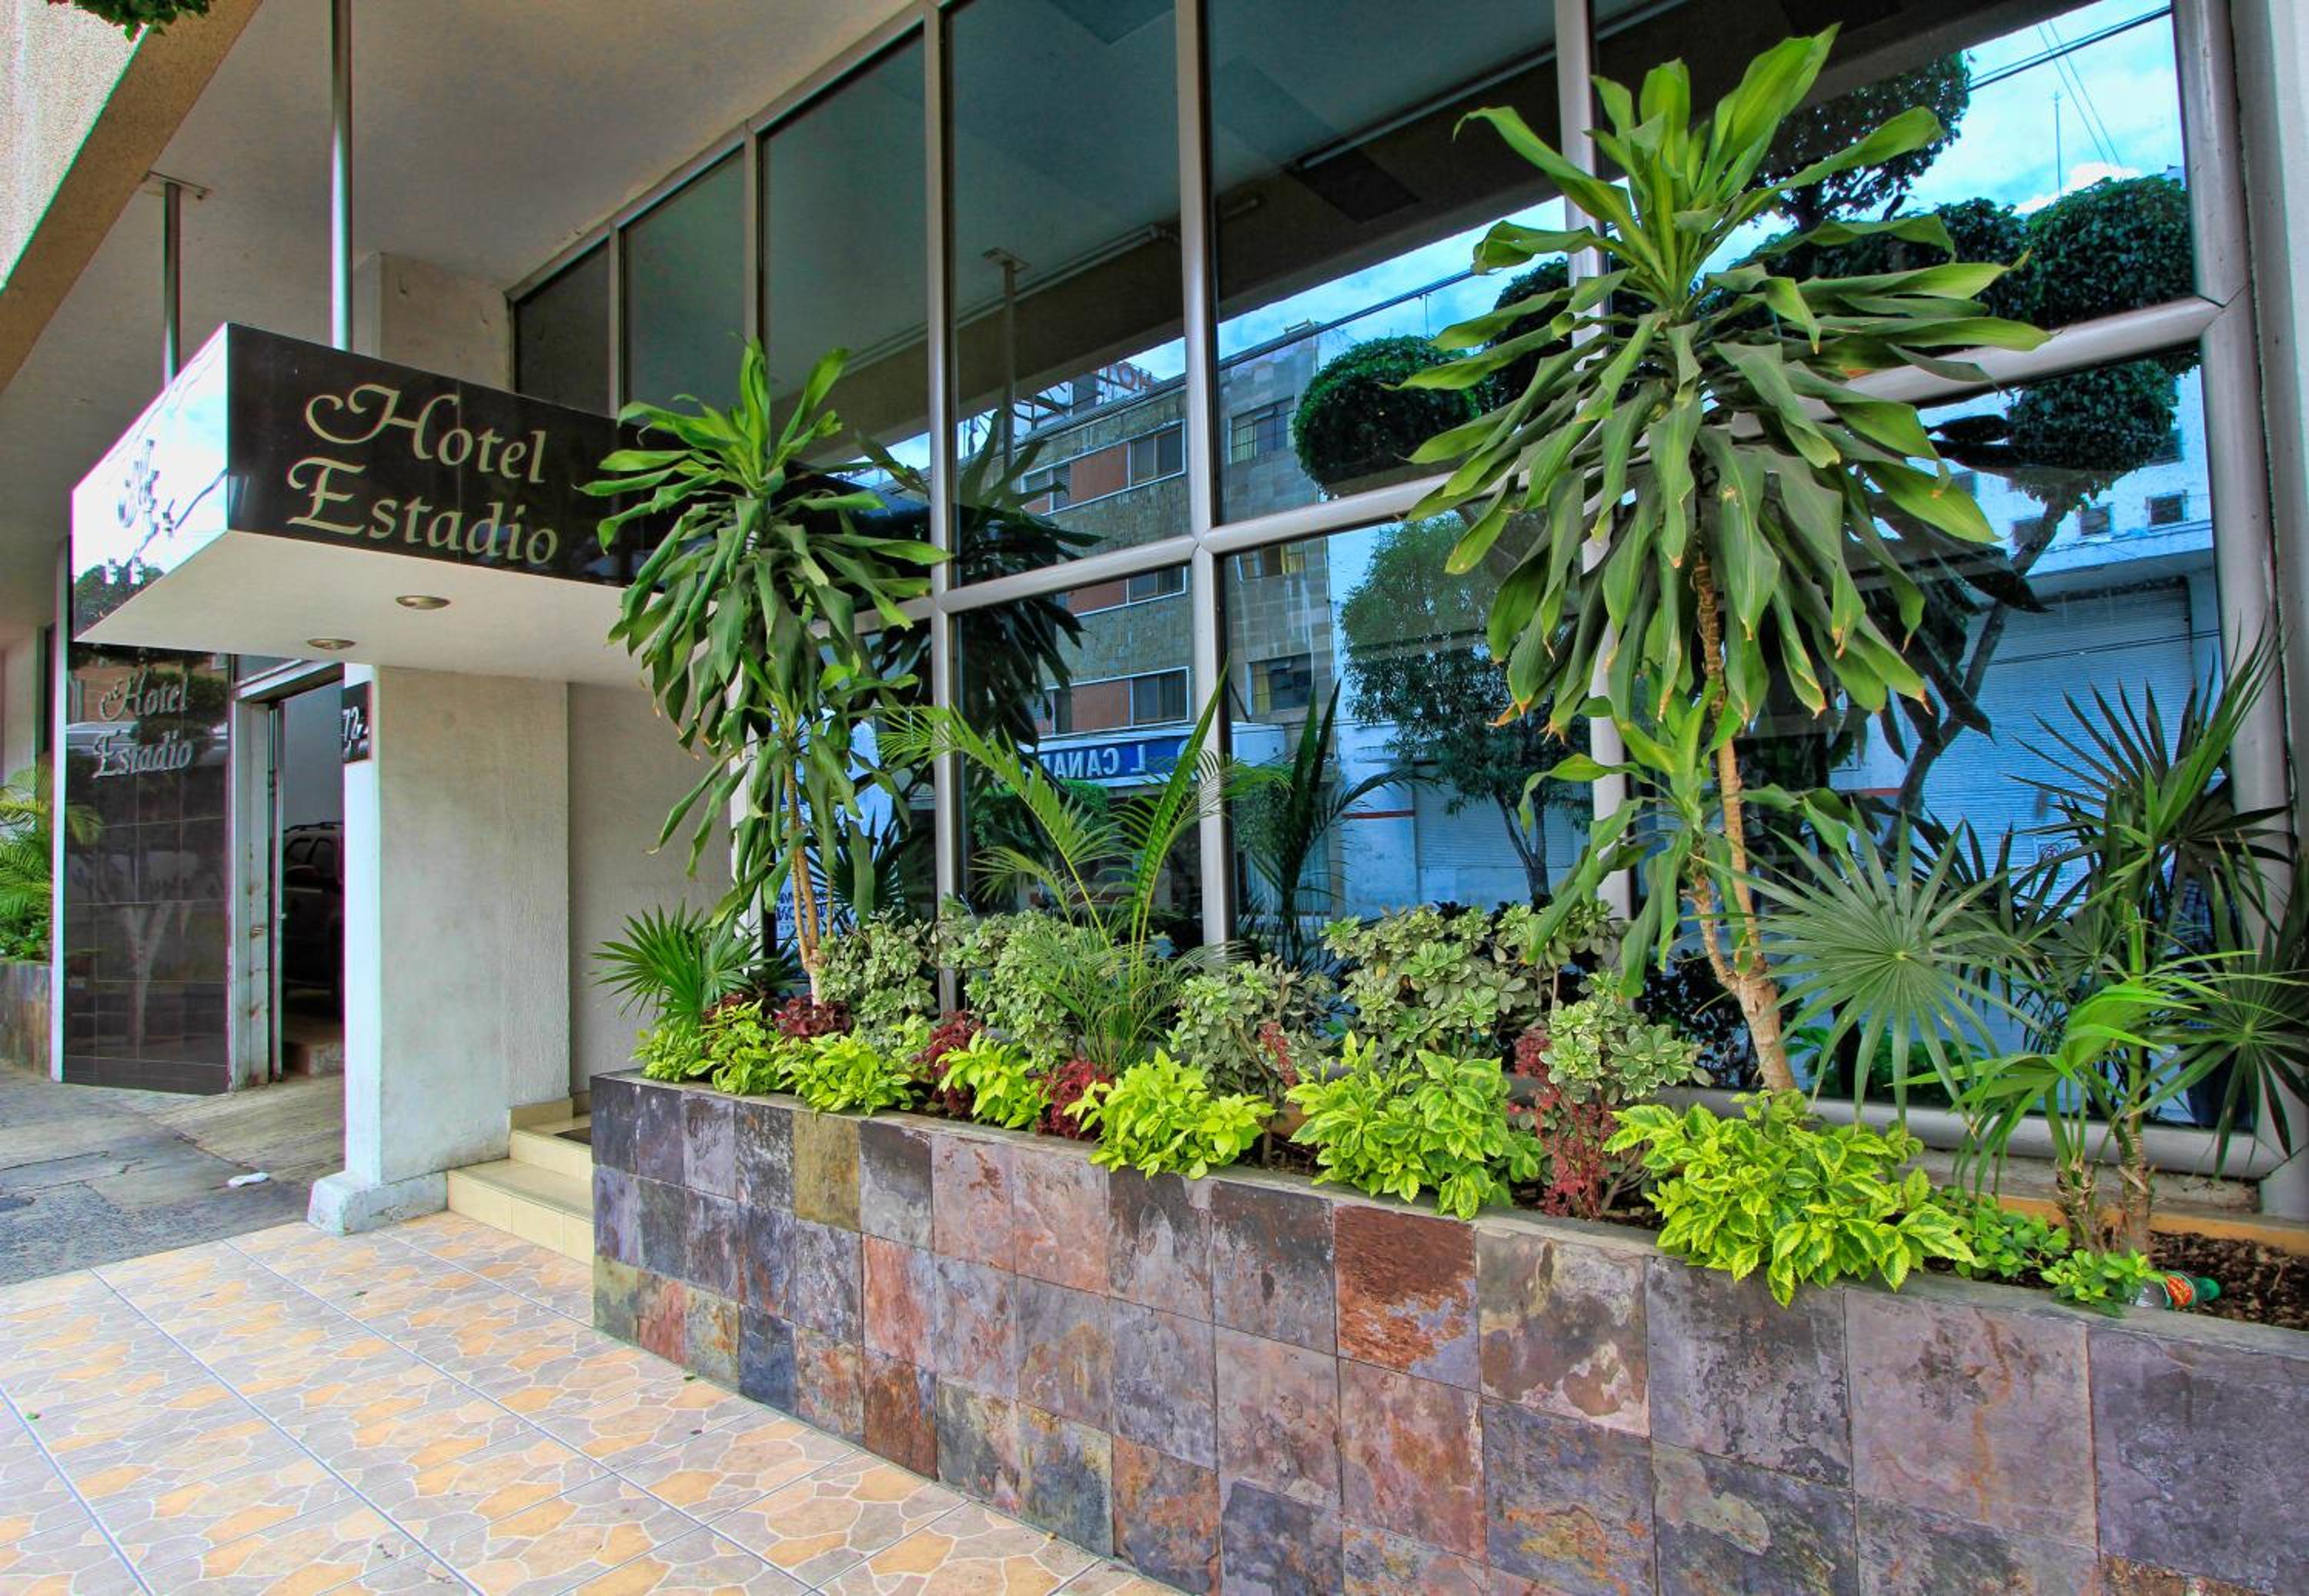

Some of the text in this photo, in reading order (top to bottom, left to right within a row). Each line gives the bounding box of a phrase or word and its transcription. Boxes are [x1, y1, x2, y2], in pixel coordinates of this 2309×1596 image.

[306, 384, 547, 483] Hotel
[287, 456, 558, 565] Estadio
[100, 666, 189, 721] Hotel
[92, 729, 192, 779] Estadio
